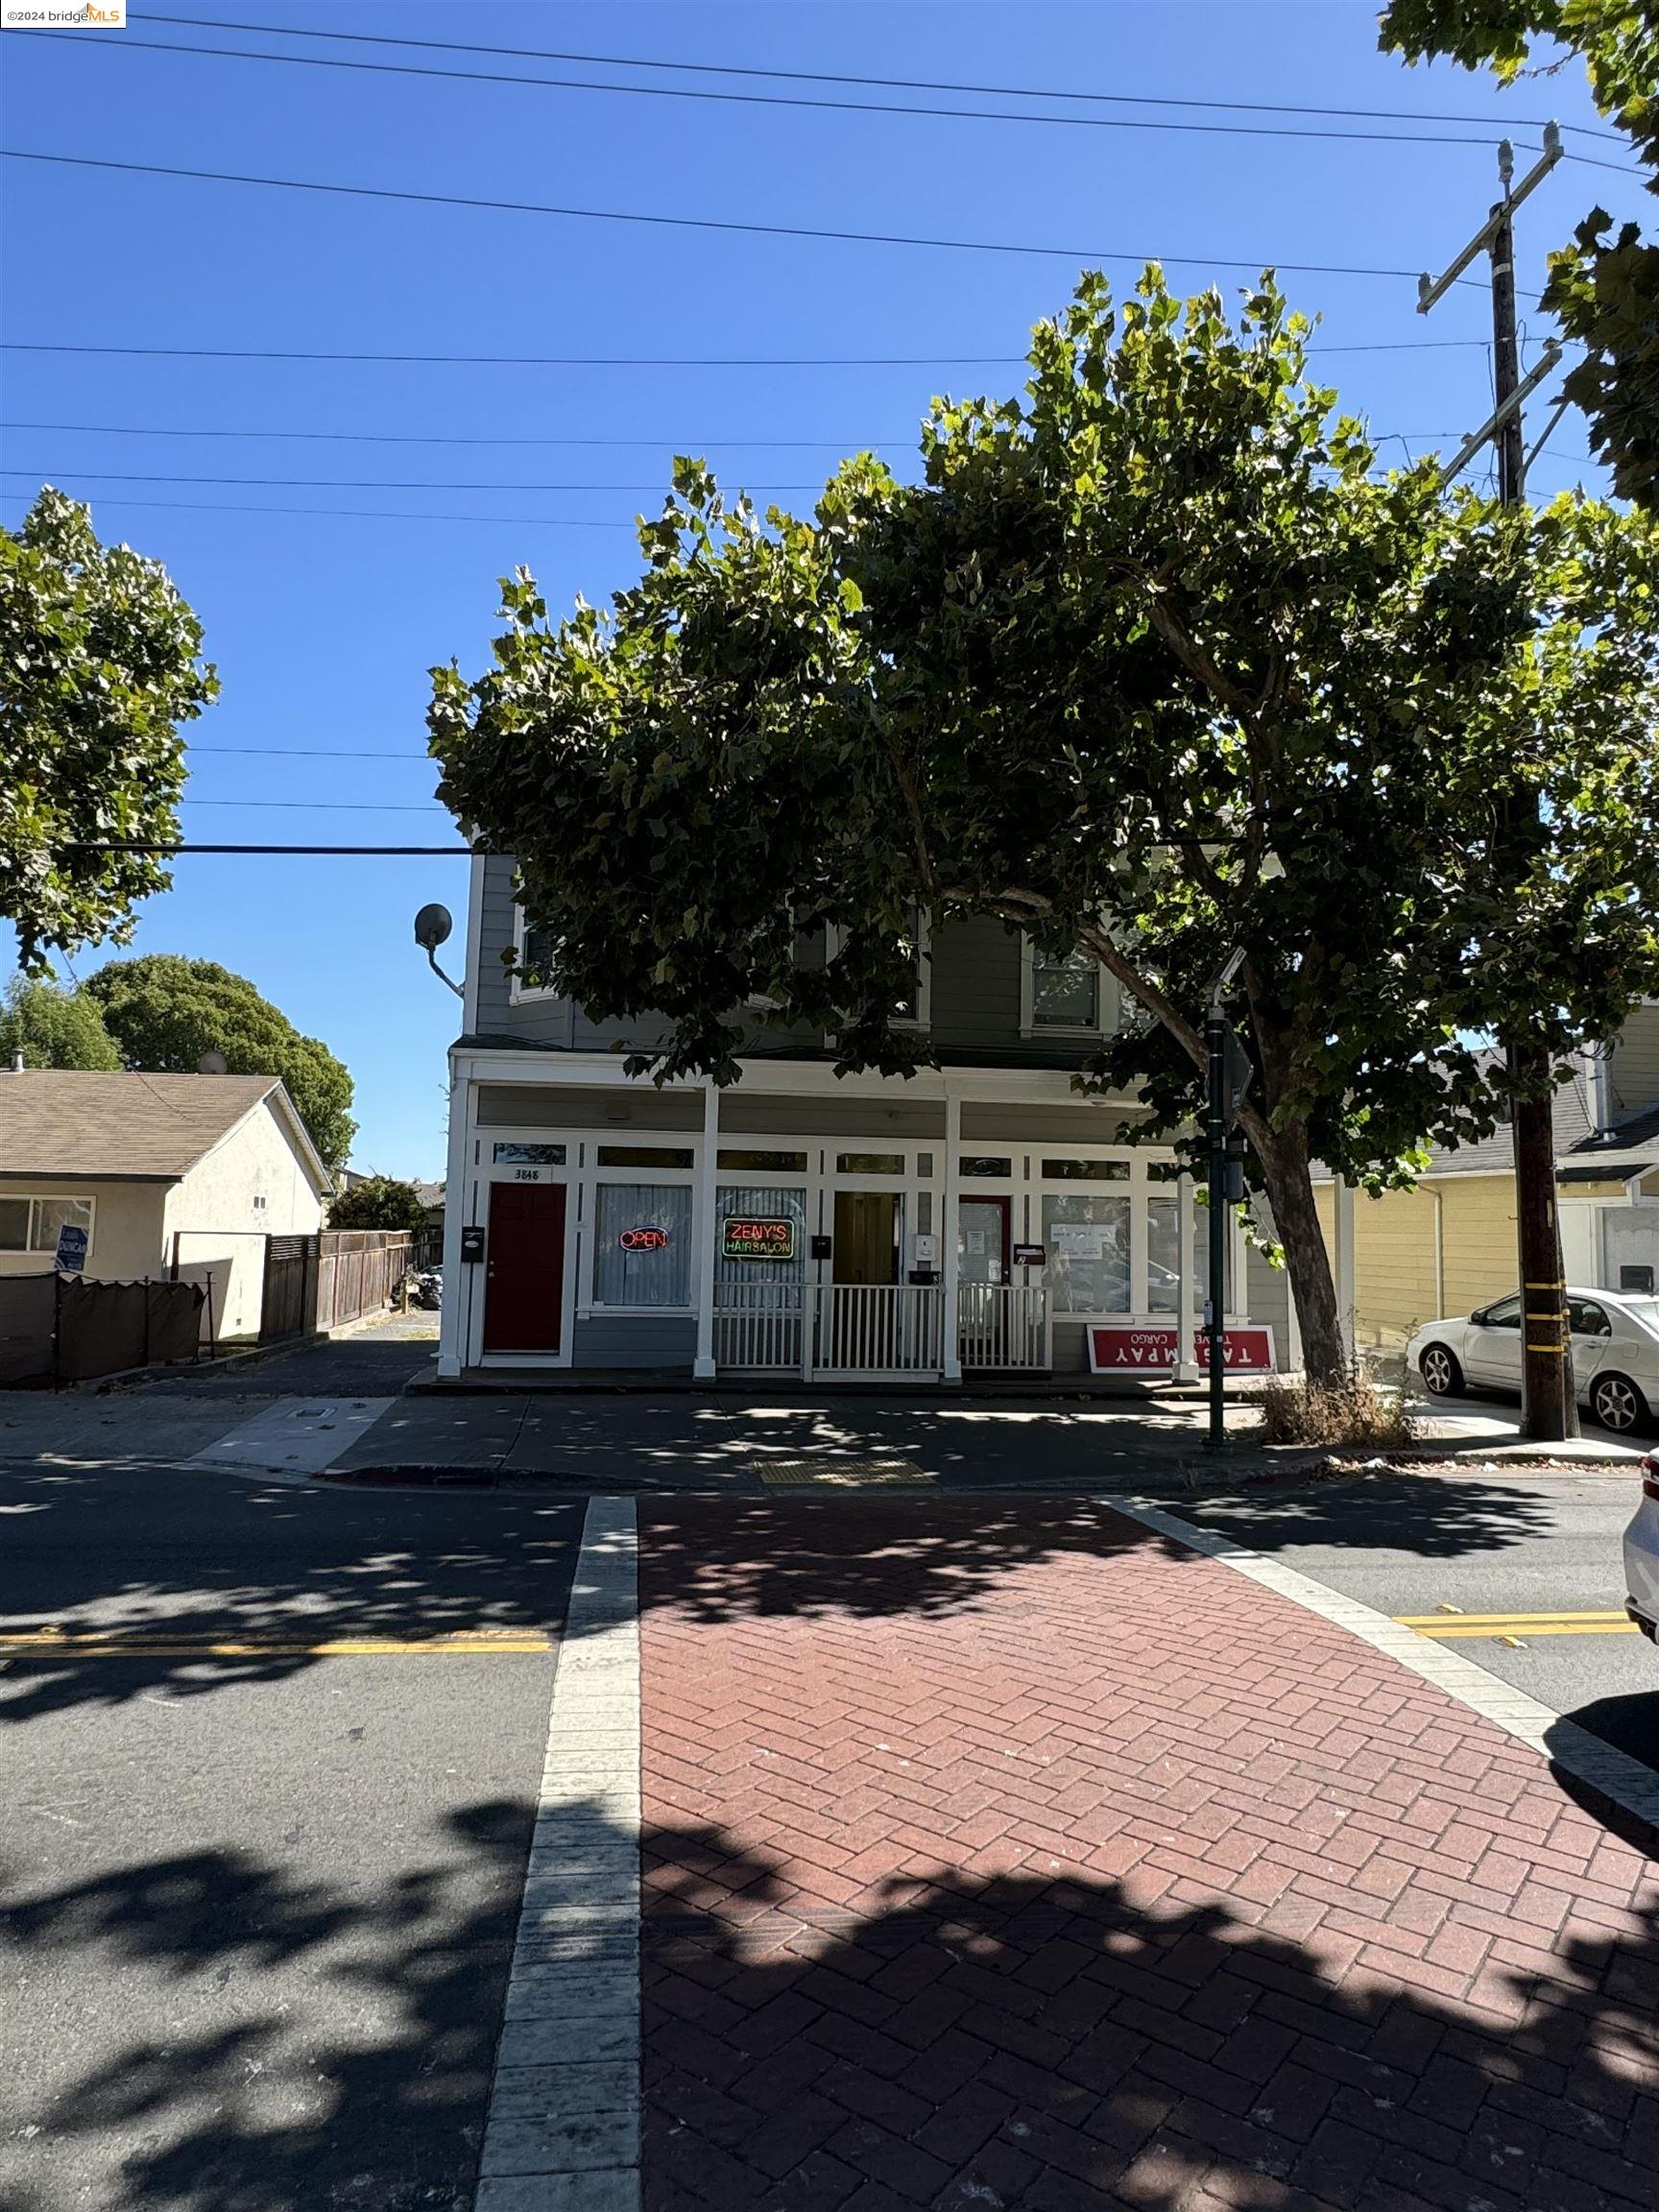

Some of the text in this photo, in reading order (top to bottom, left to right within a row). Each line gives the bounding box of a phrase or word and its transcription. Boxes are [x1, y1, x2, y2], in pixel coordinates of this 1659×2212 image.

[514, 1168, 540, 1180] 3848
[731, 1223, 786, 1240] ZENY'S
[619, 1231, 667, 1248] OPEN
[1130, 1334, 1168, 1344] CARGO
